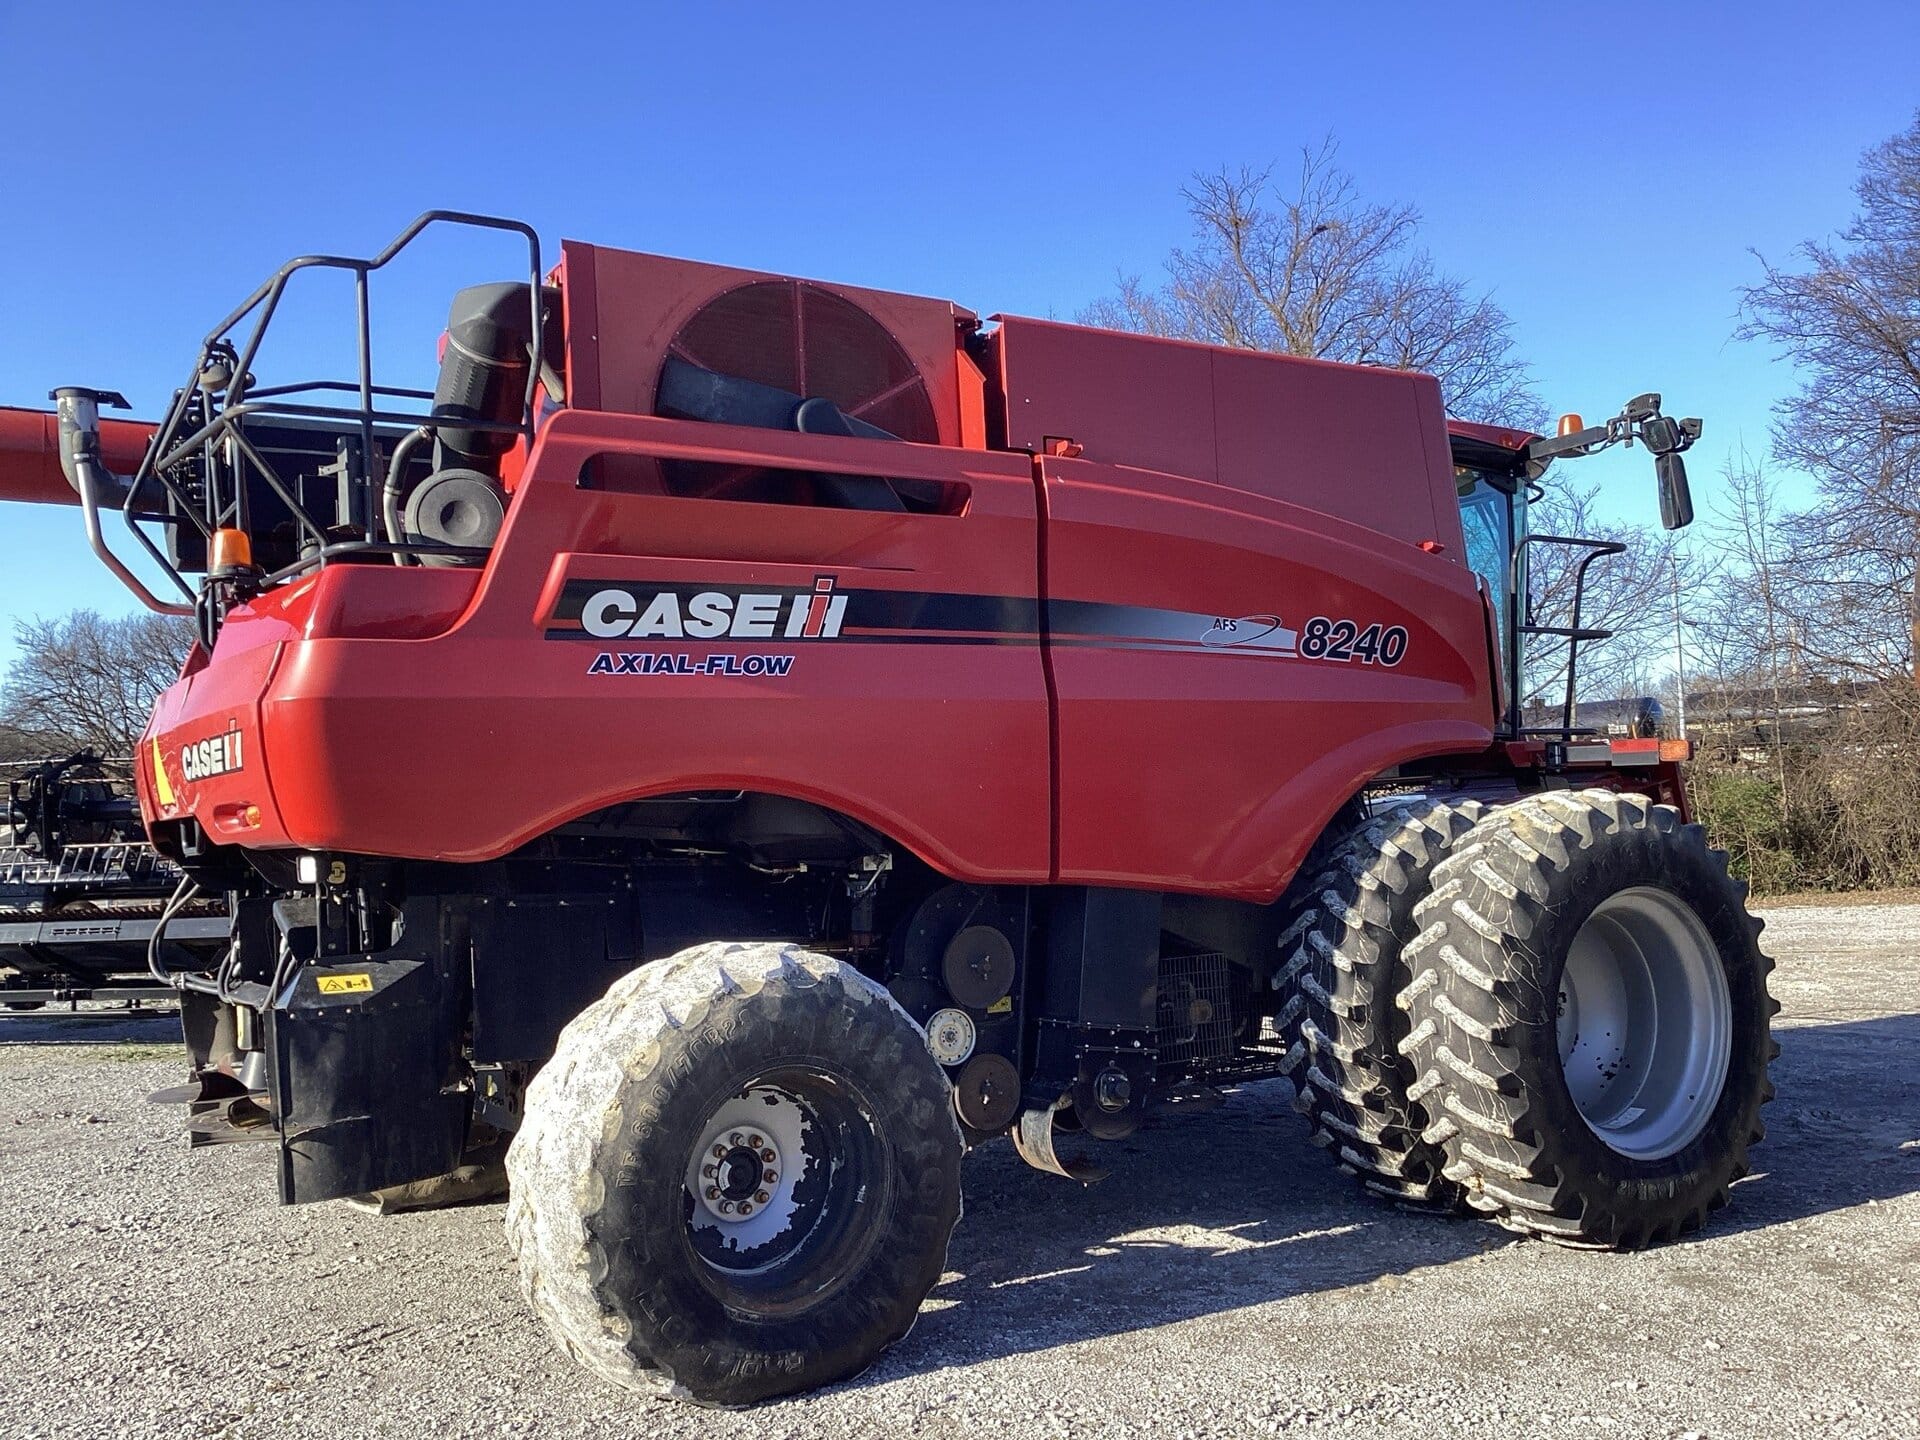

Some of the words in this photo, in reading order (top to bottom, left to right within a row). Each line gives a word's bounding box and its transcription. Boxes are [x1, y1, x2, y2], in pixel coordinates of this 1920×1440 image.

[580, 590, 781, 638] CASE
[1213, 617, 1237, 633] AFS
[1300, 616, 1409, 667] 8240
[587, 653, 796, 676] AXIAL-FLOW
[181, 737, 224, 782] CASE
